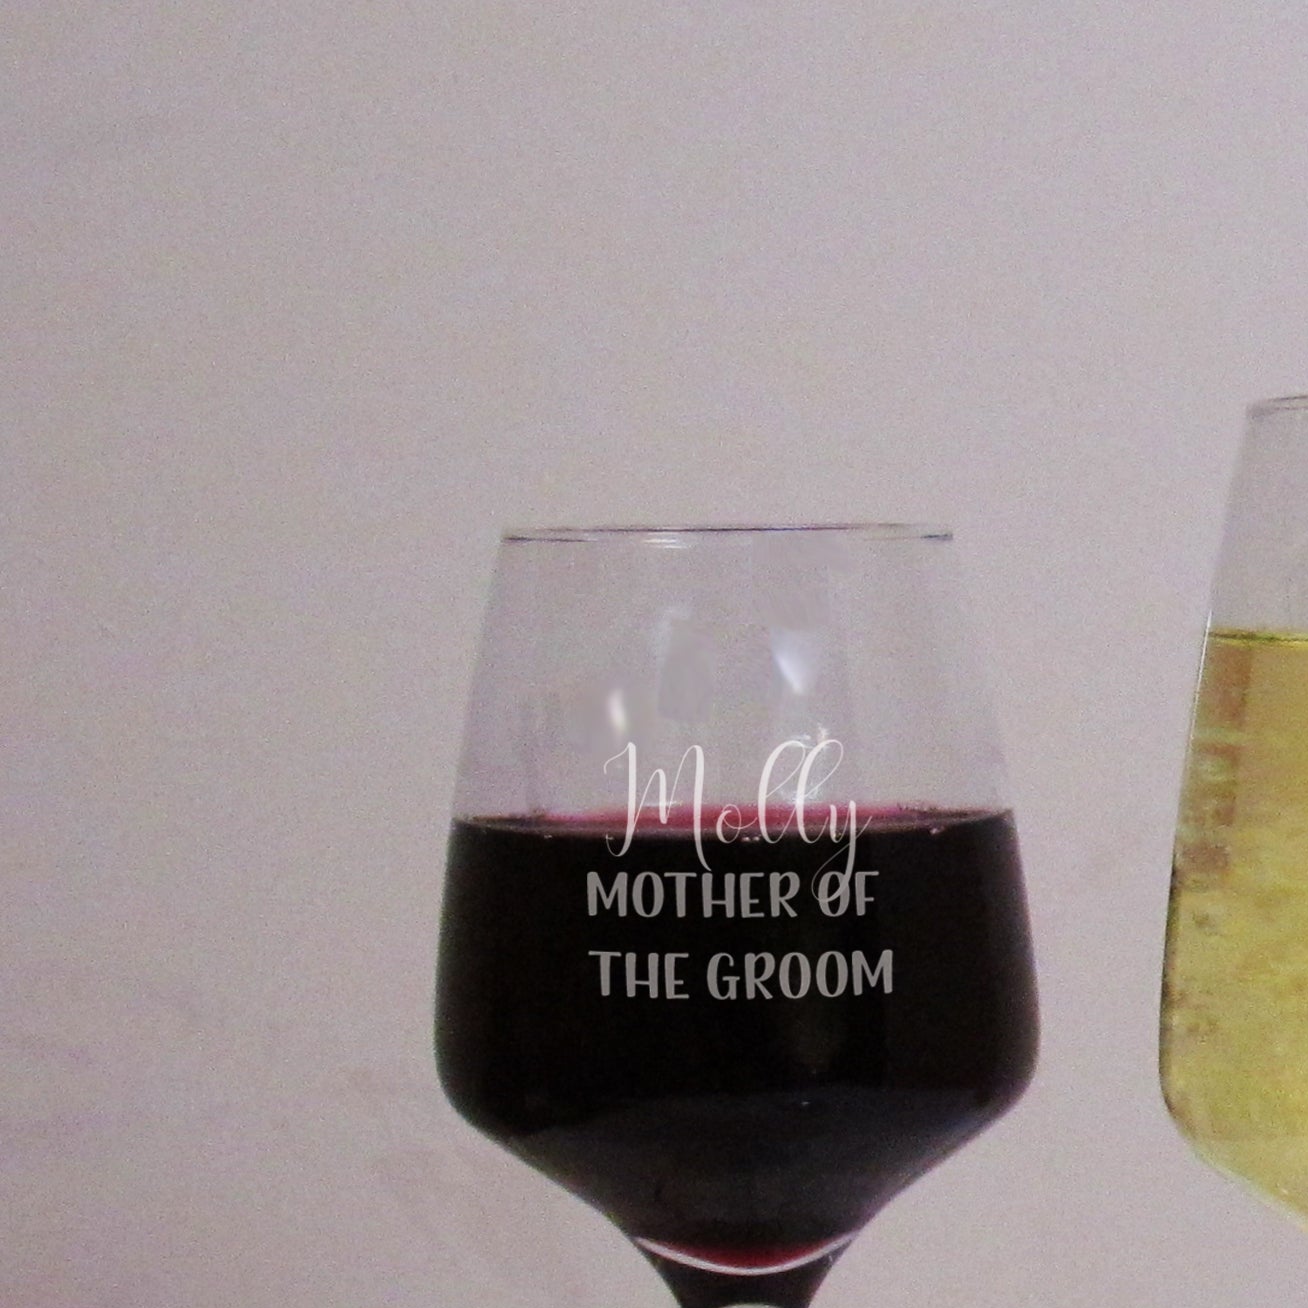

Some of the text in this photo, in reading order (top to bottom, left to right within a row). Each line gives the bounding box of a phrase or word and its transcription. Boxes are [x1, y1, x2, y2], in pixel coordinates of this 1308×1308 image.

[603, 739, 873, 902] Molly
[586, 870, 880, 918] MOTHER OF
[588, 949, 894, 1000] THE GROOM
